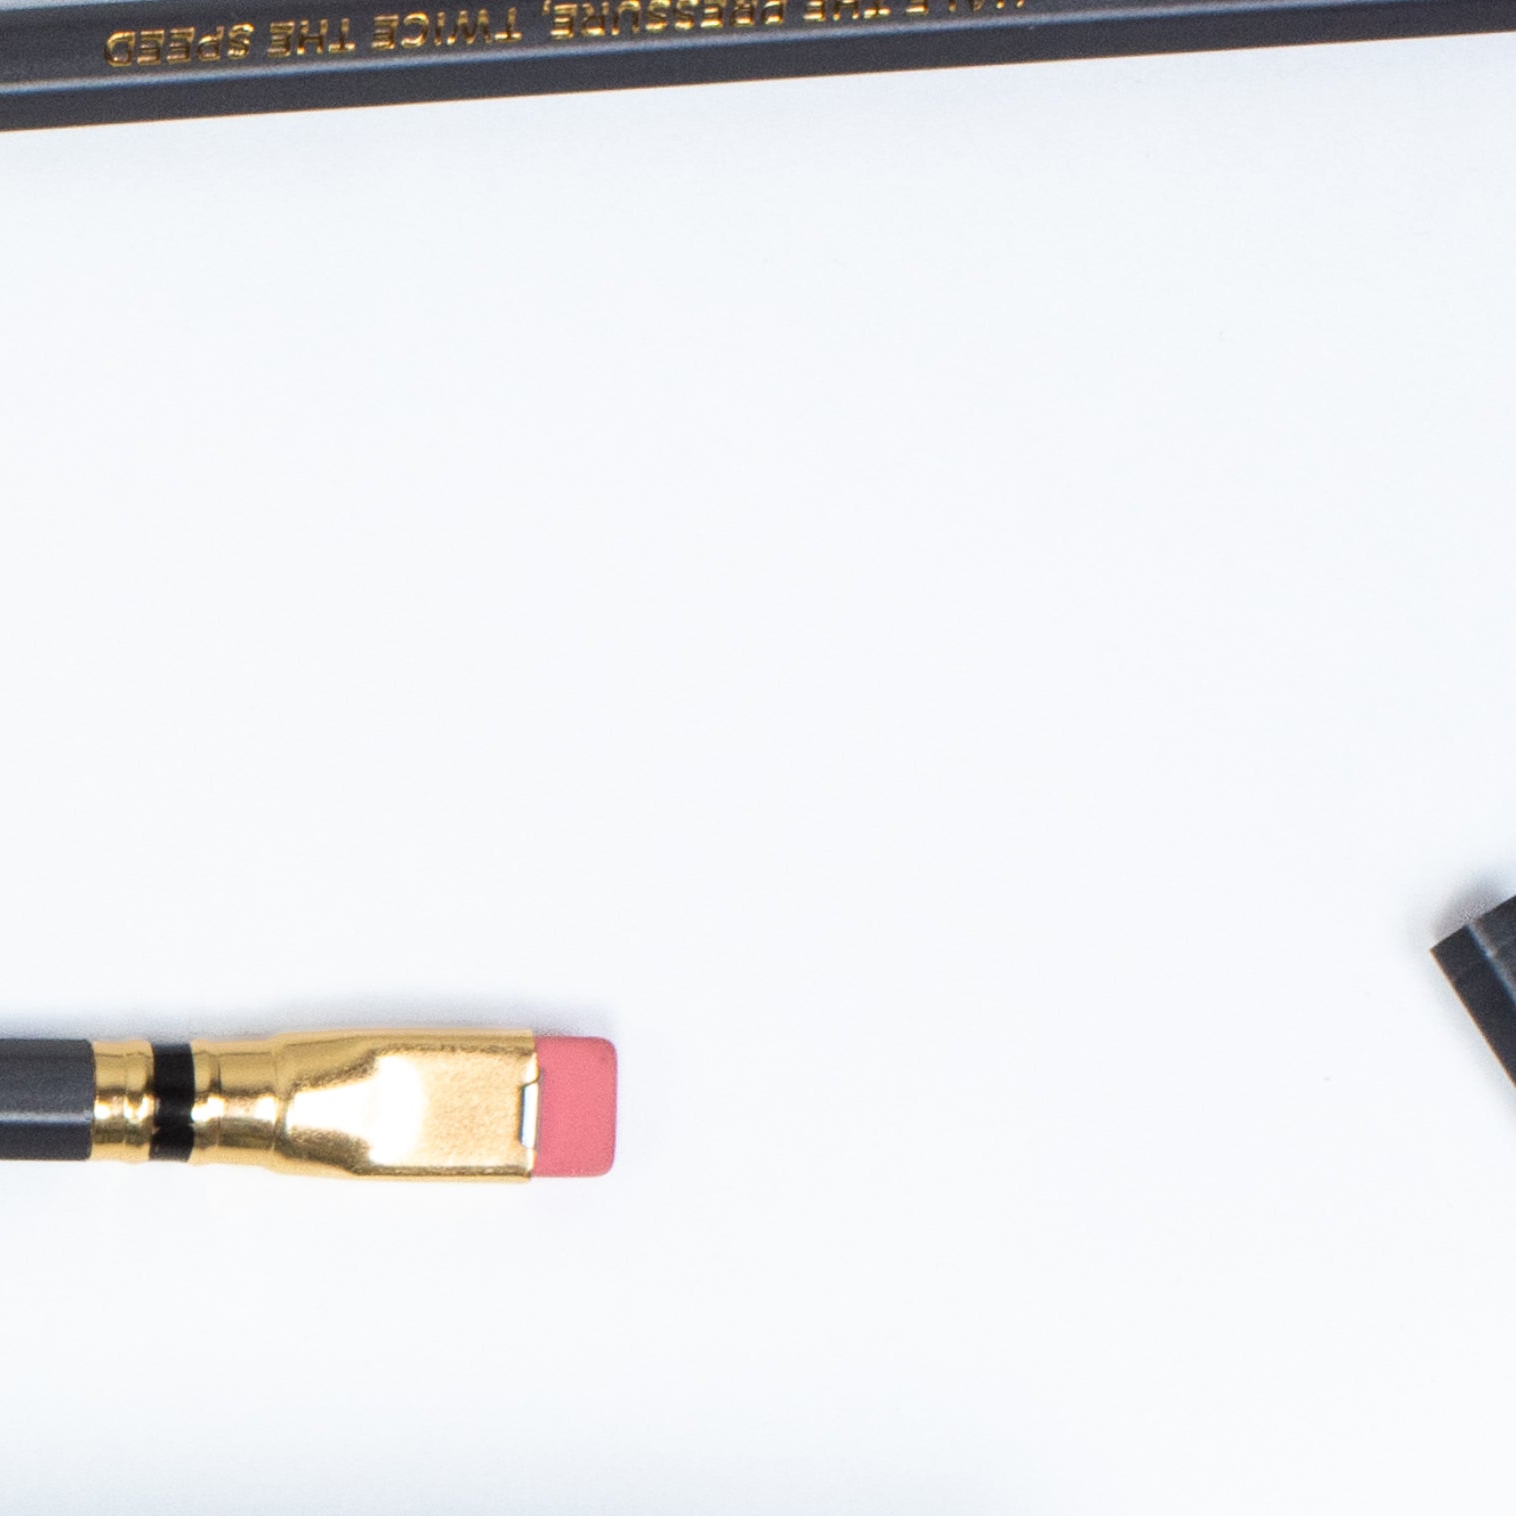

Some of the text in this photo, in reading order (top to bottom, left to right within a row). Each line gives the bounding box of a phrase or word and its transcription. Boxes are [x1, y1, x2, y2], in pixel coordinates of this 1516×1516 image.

[104, 23, 254, 67] SPEED
[267, 18, 356, 57] THE
[371, 7, 522, 49] TWICE
